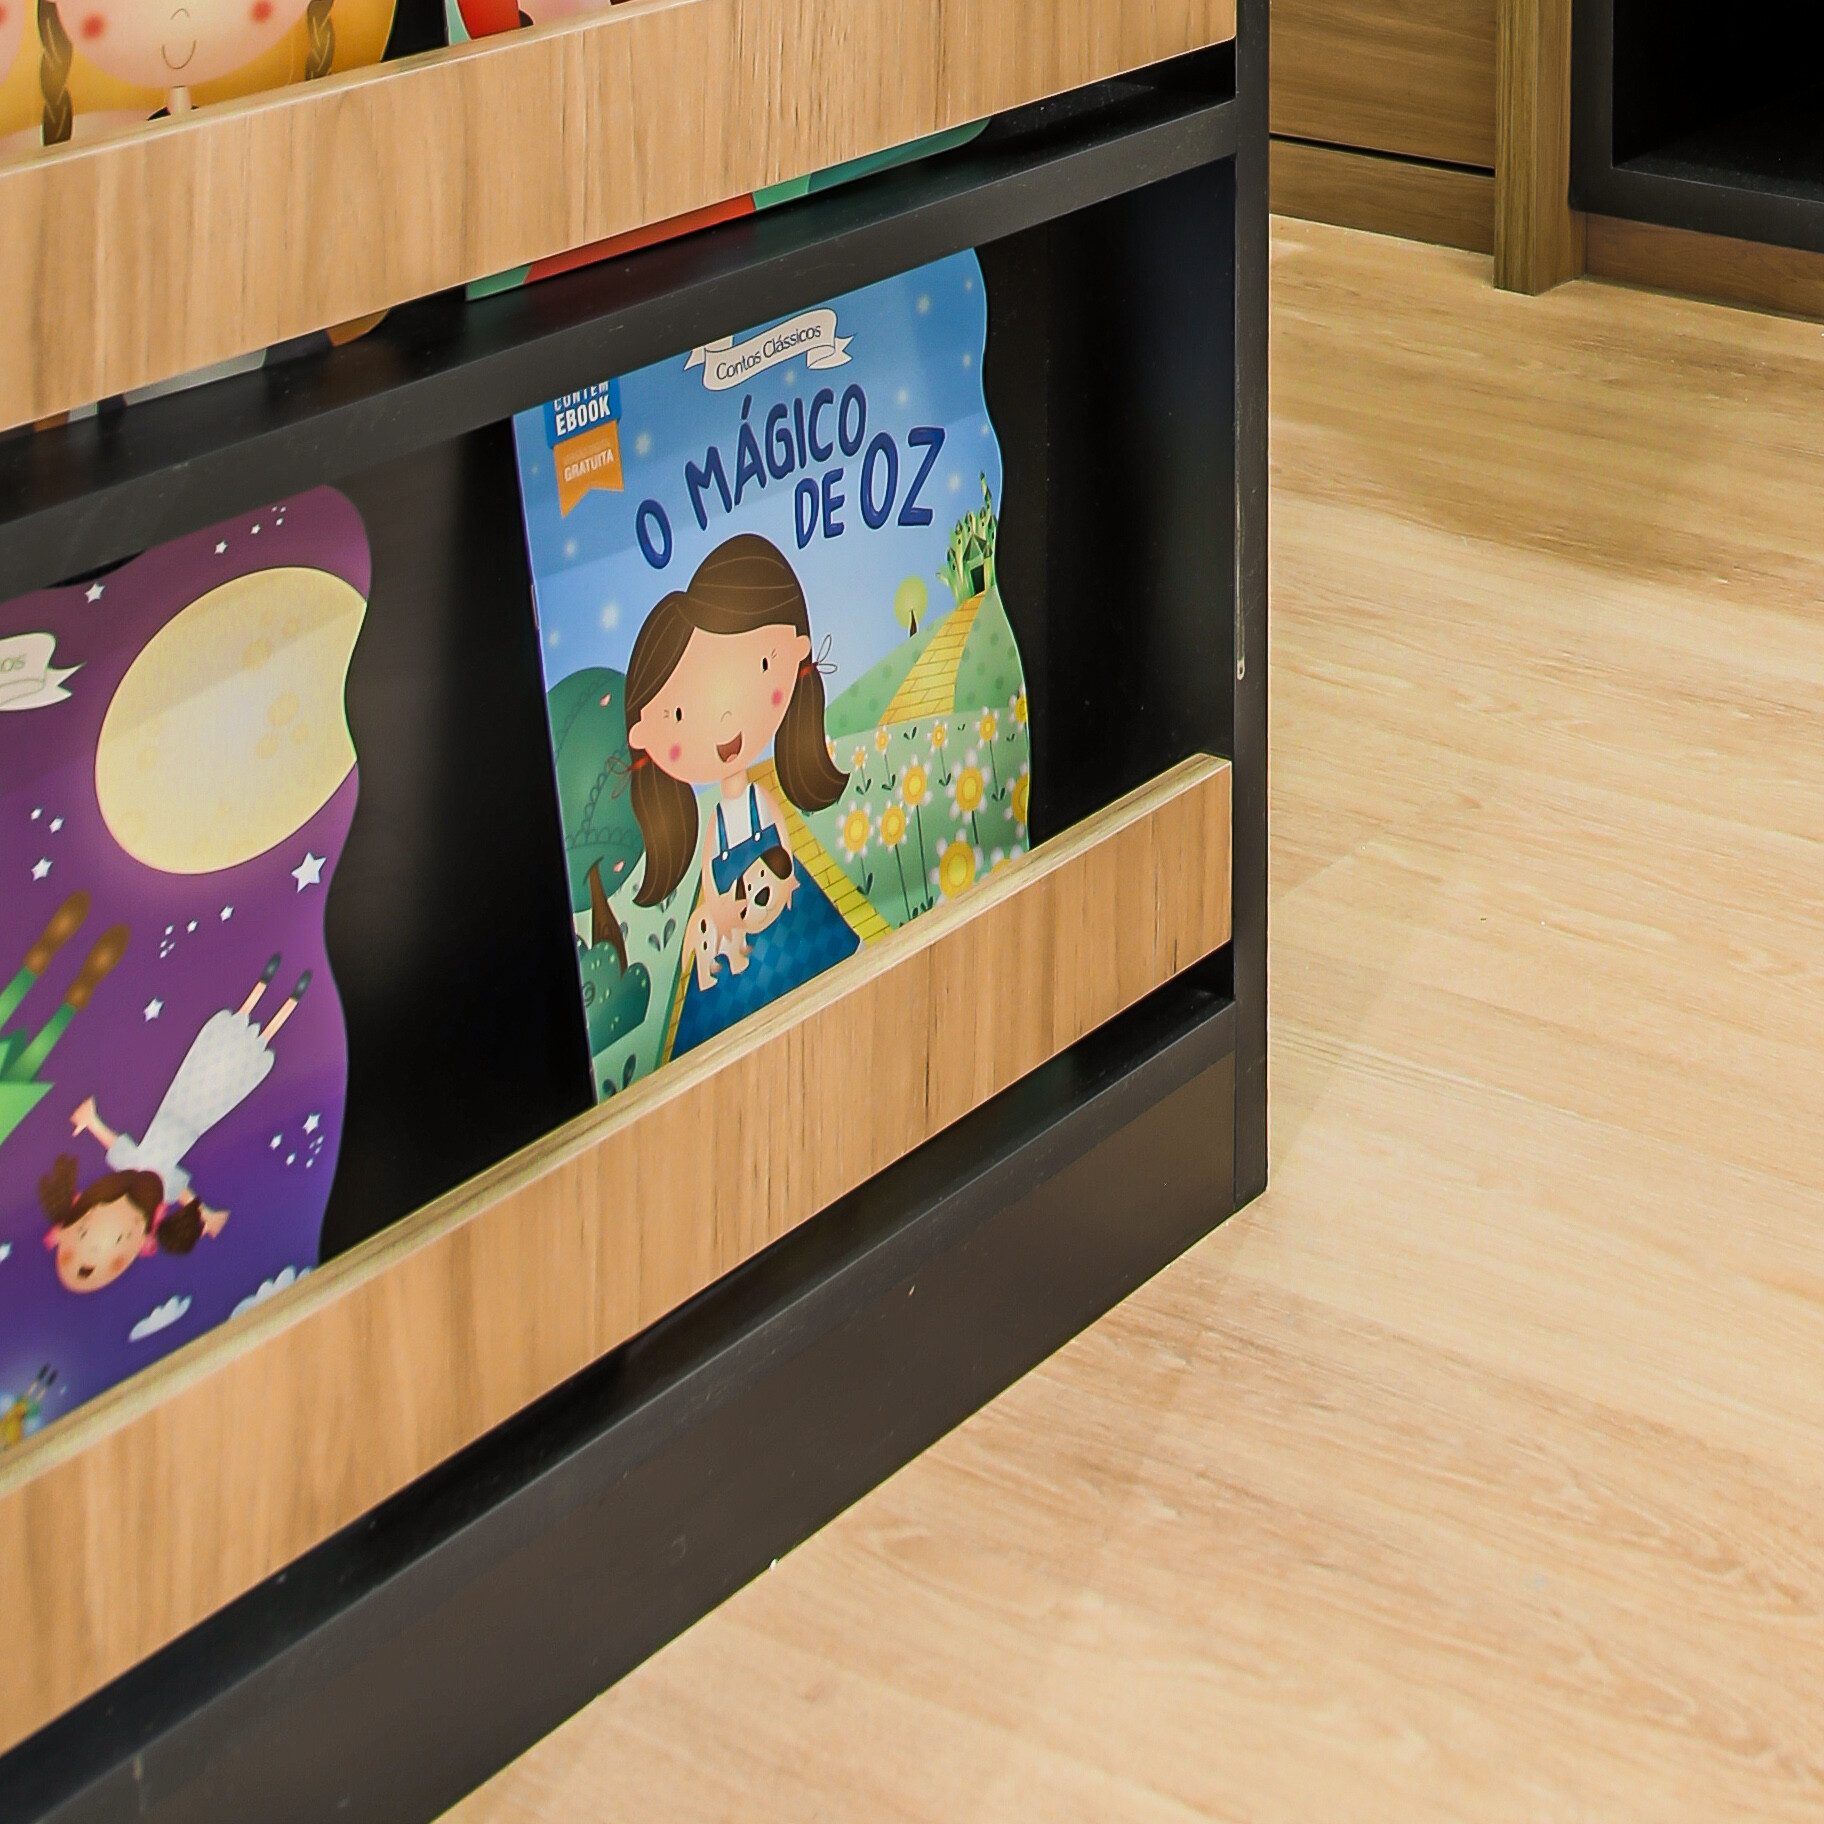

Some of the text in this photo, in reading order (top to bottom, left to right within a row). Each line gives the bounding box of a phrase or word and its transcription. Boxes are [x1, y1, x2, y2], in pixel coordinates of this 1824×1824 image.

[716, 325, 821, 380] Contos Clássicos
[555, 394, 611, 437] EBOOK
[564, 448, 614, 483] GRATUITA
[635, 383, 867, 570] O MÁGICO
[795, 426, 946, 550] DE OZ
